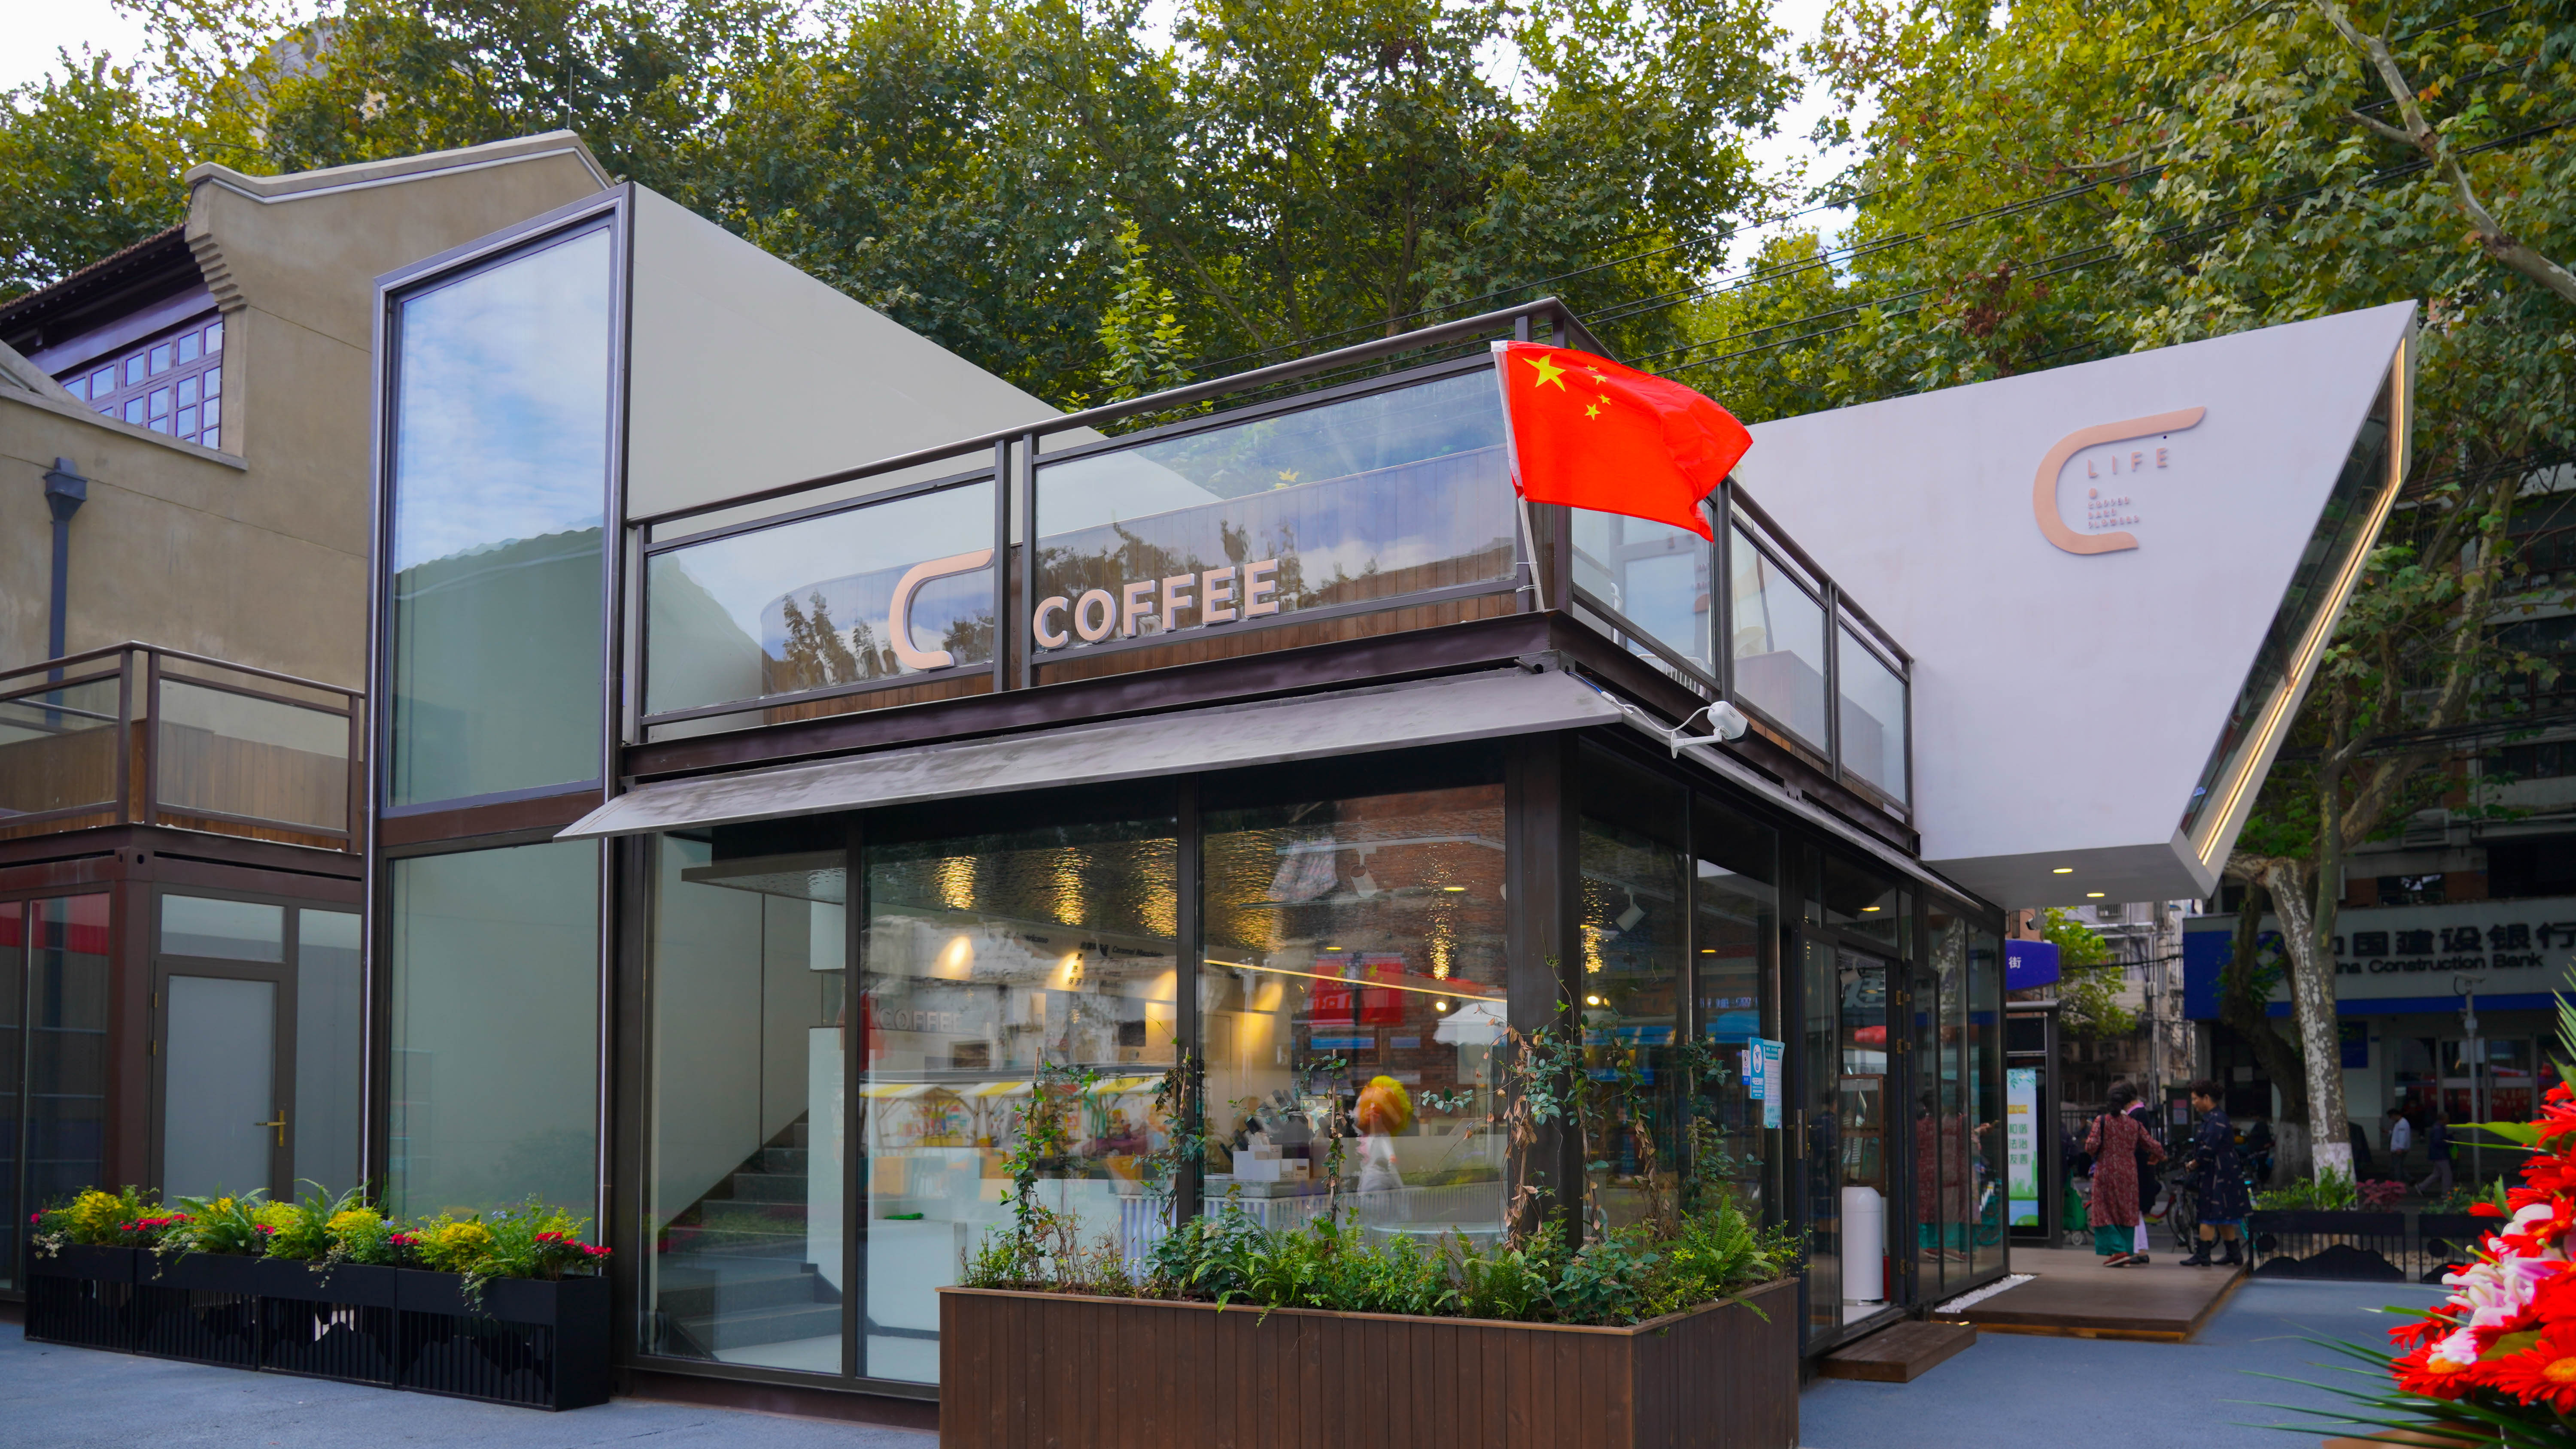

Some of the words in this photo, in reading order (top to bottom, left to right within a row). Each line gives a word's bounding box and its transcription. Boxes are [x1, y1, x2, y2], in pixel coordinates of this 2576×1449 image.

[2088, 447, 2167, 478] LIFE
[2088, 515, 2139, 528] FLOWERS
[1033, 558, 1279, 649] COFFEE
[2008, 956, 2022, 969] 街
[2335, 960, 2362, 974] ina
[2368, 954, 2486, 974] Construction
[2492, 952, 2543, 969] Bank
[2009, 1124, 2028, 1134] 和谐
[2009, 1139, 2028, 1149] 法治
[2009, 1154, 2028, 1165] 友善
